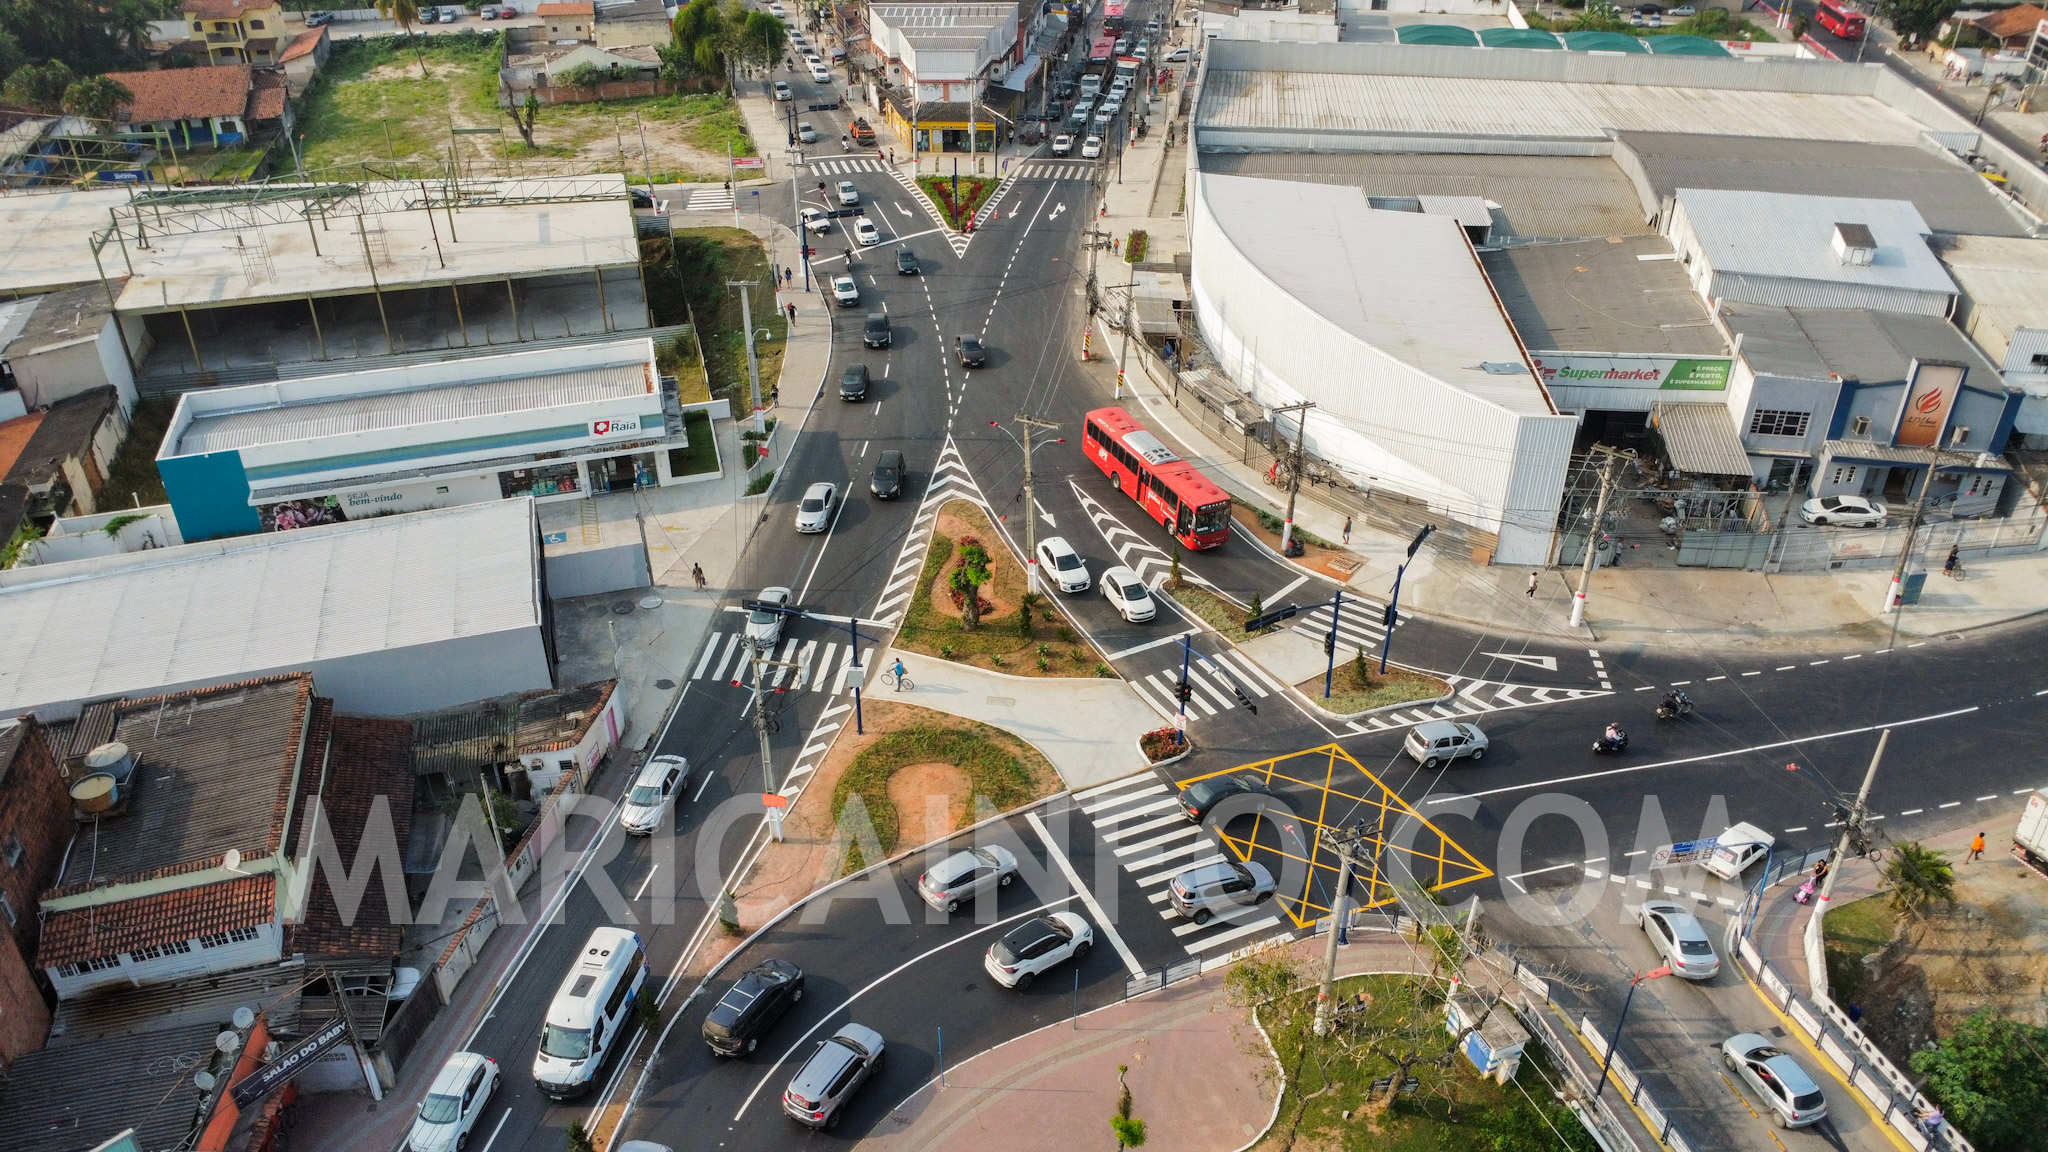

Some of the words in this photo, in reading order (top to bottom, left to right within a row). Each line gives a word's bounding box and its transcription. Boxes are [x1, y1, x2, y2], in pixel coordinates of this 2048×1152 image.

[1558, 366, 1661, 381] Supermarket
[611, 422, 636, 432] Raia
[347, 492, 370, 500] SEJA
[349, 492, 403, 507] bem-vindo
[300, 1041, 318, 1057] DO
[317, 1021, 347, 1046] BABY
